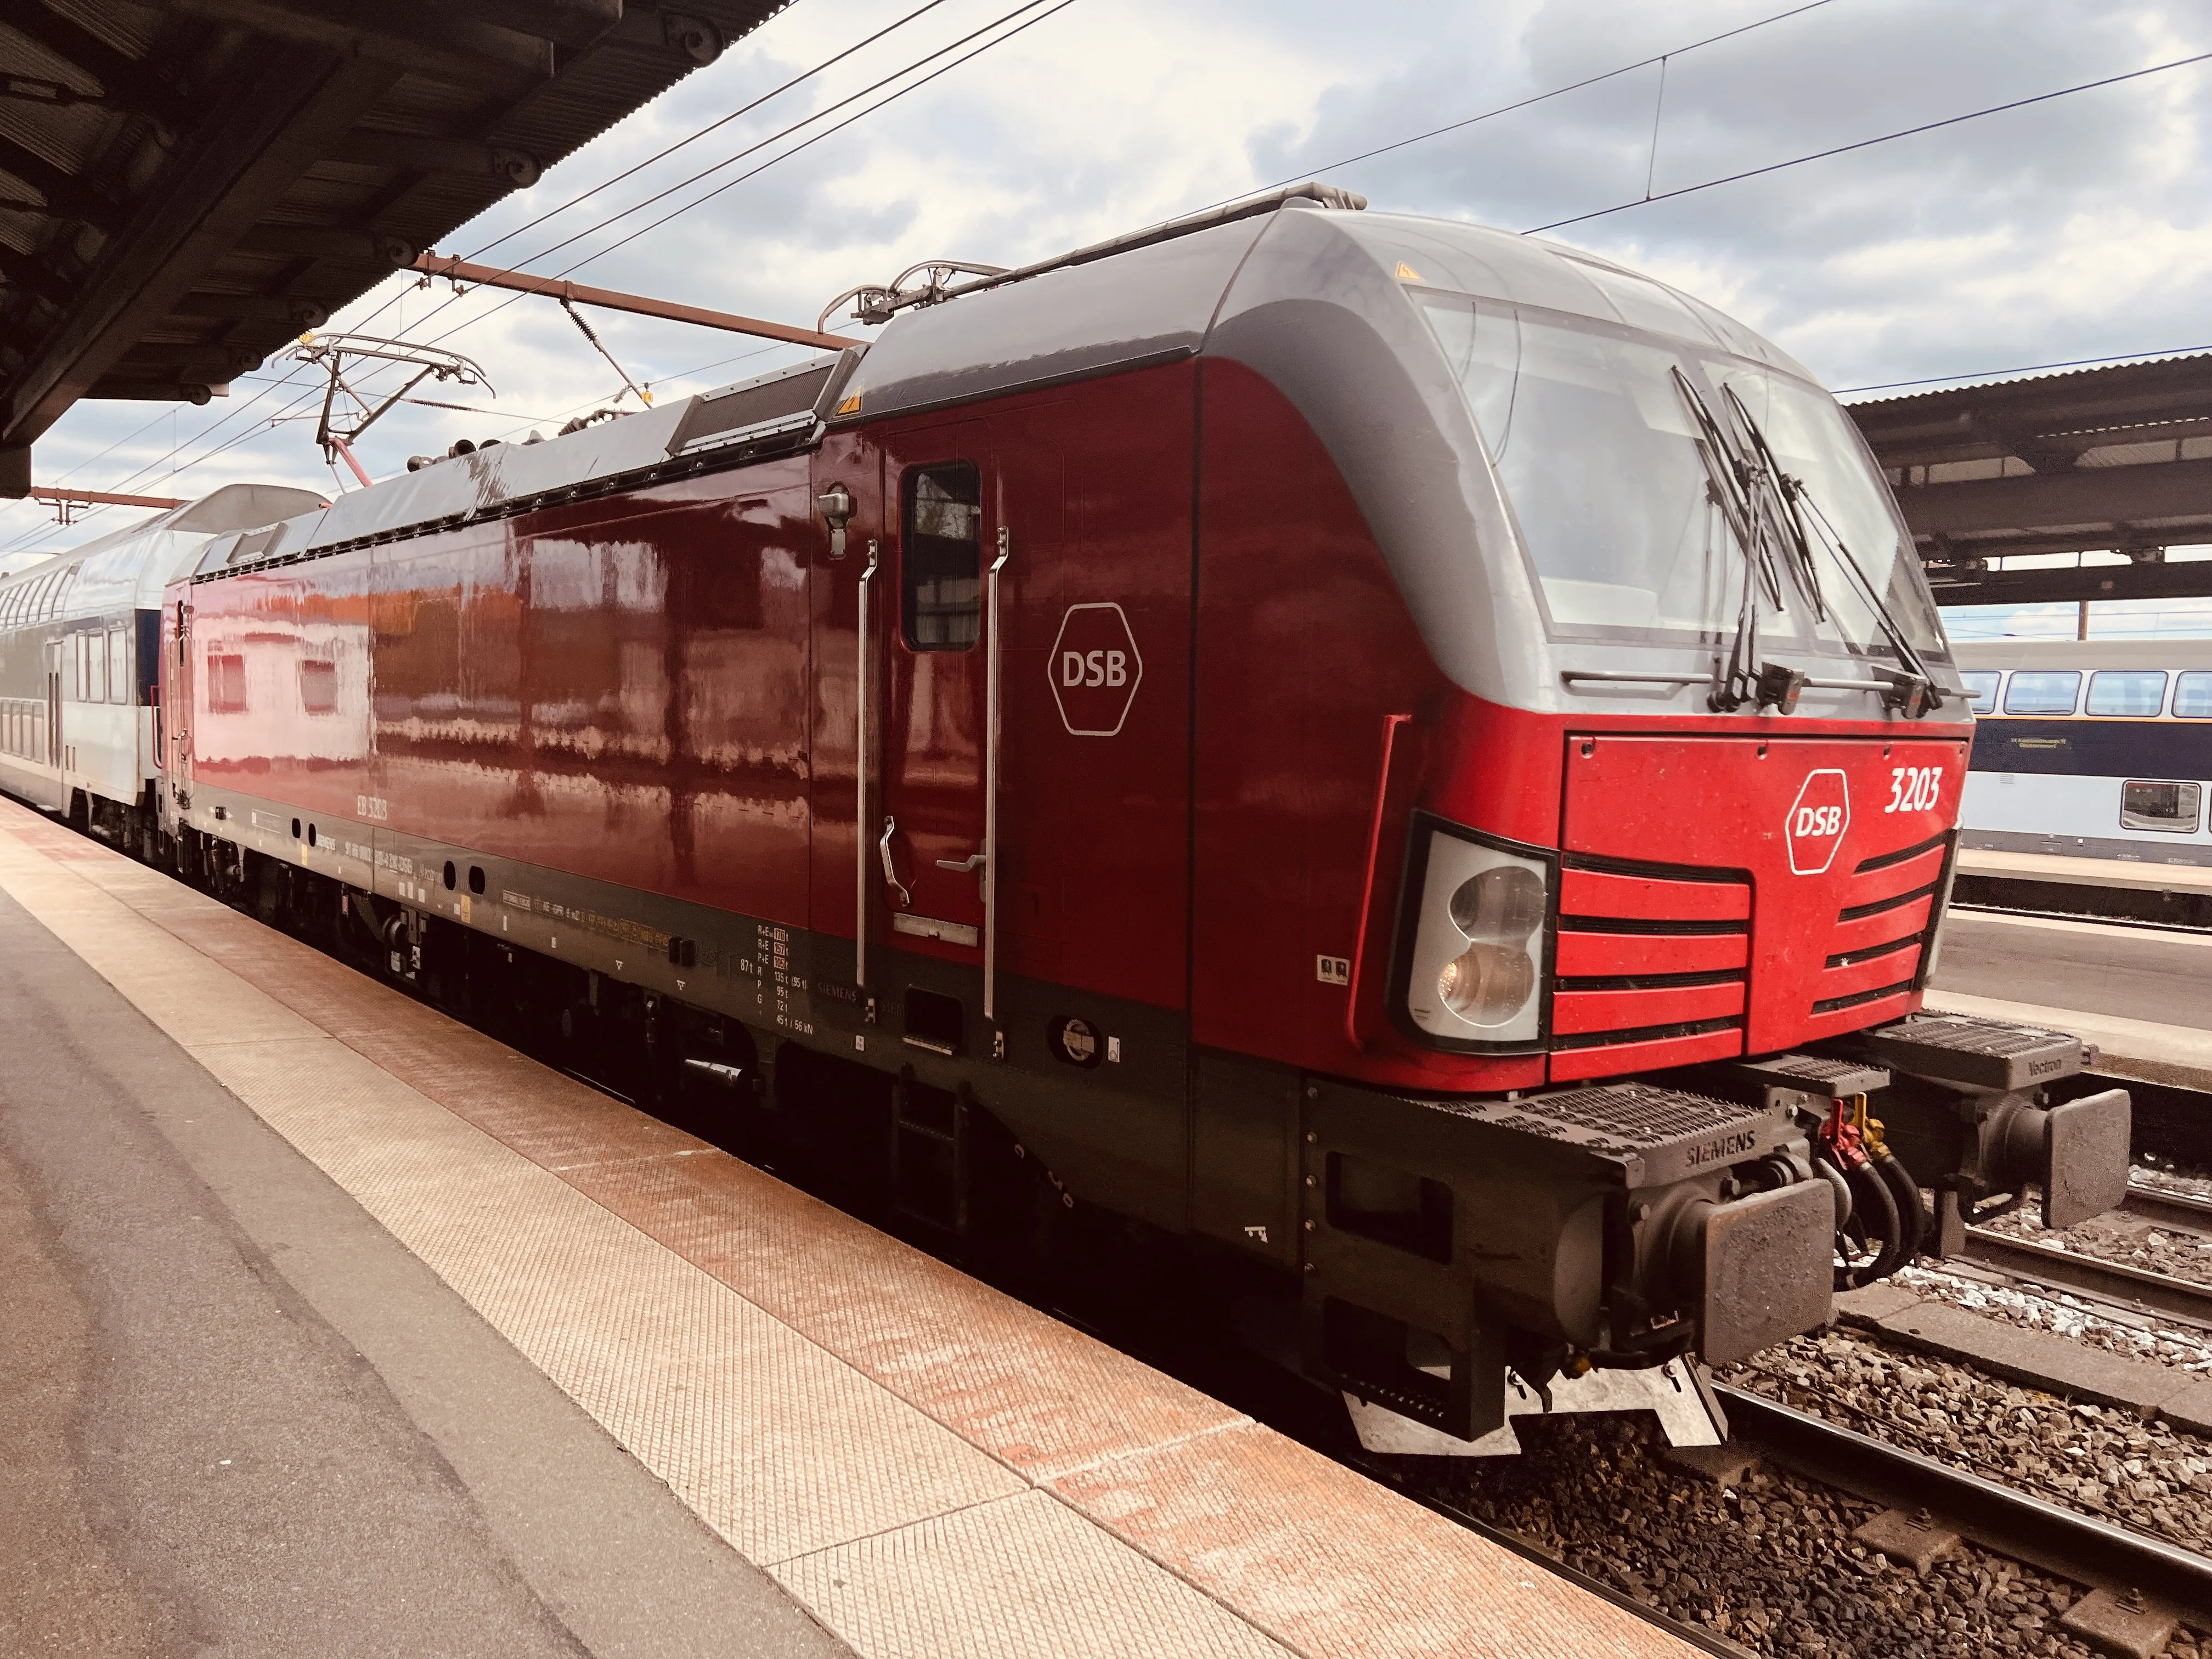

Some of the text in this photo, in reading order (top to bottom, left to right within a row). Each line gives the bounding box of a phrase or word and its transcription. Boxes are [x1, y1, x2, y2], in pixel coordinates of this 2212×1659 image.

[1063, 650, 1126, 687] DSB
[1884, 767, 1943, 814] 3203
[1796, 806, 1842, 837] DSB
[786, 933, 789, 942] t
[758, 938, 789, 956] R+E 157 t
[741, 958, 753, 974] 87 t
[758, 952, 789, 970] P+E 105 t
[758, 966, 762, 977] R
[774, 971, 785, 983] 135
[785, 975, 788, 984] t
[758, 980, 788, 998] P 95 t
[817, 983, 857, 1002] SIEMENS
[757, 994, 788, 1012] G 72 t
[777, 1014, 784, 1025] 45
[785, 1017, 788, 1026] t
[795, 1020, 803, 1031] 56
[804, 1023, 813, 1035] kN
[2028, 1059, 2062, 1076] Vectron
[1685, 1130, 1756, 1167] SIEMENS
